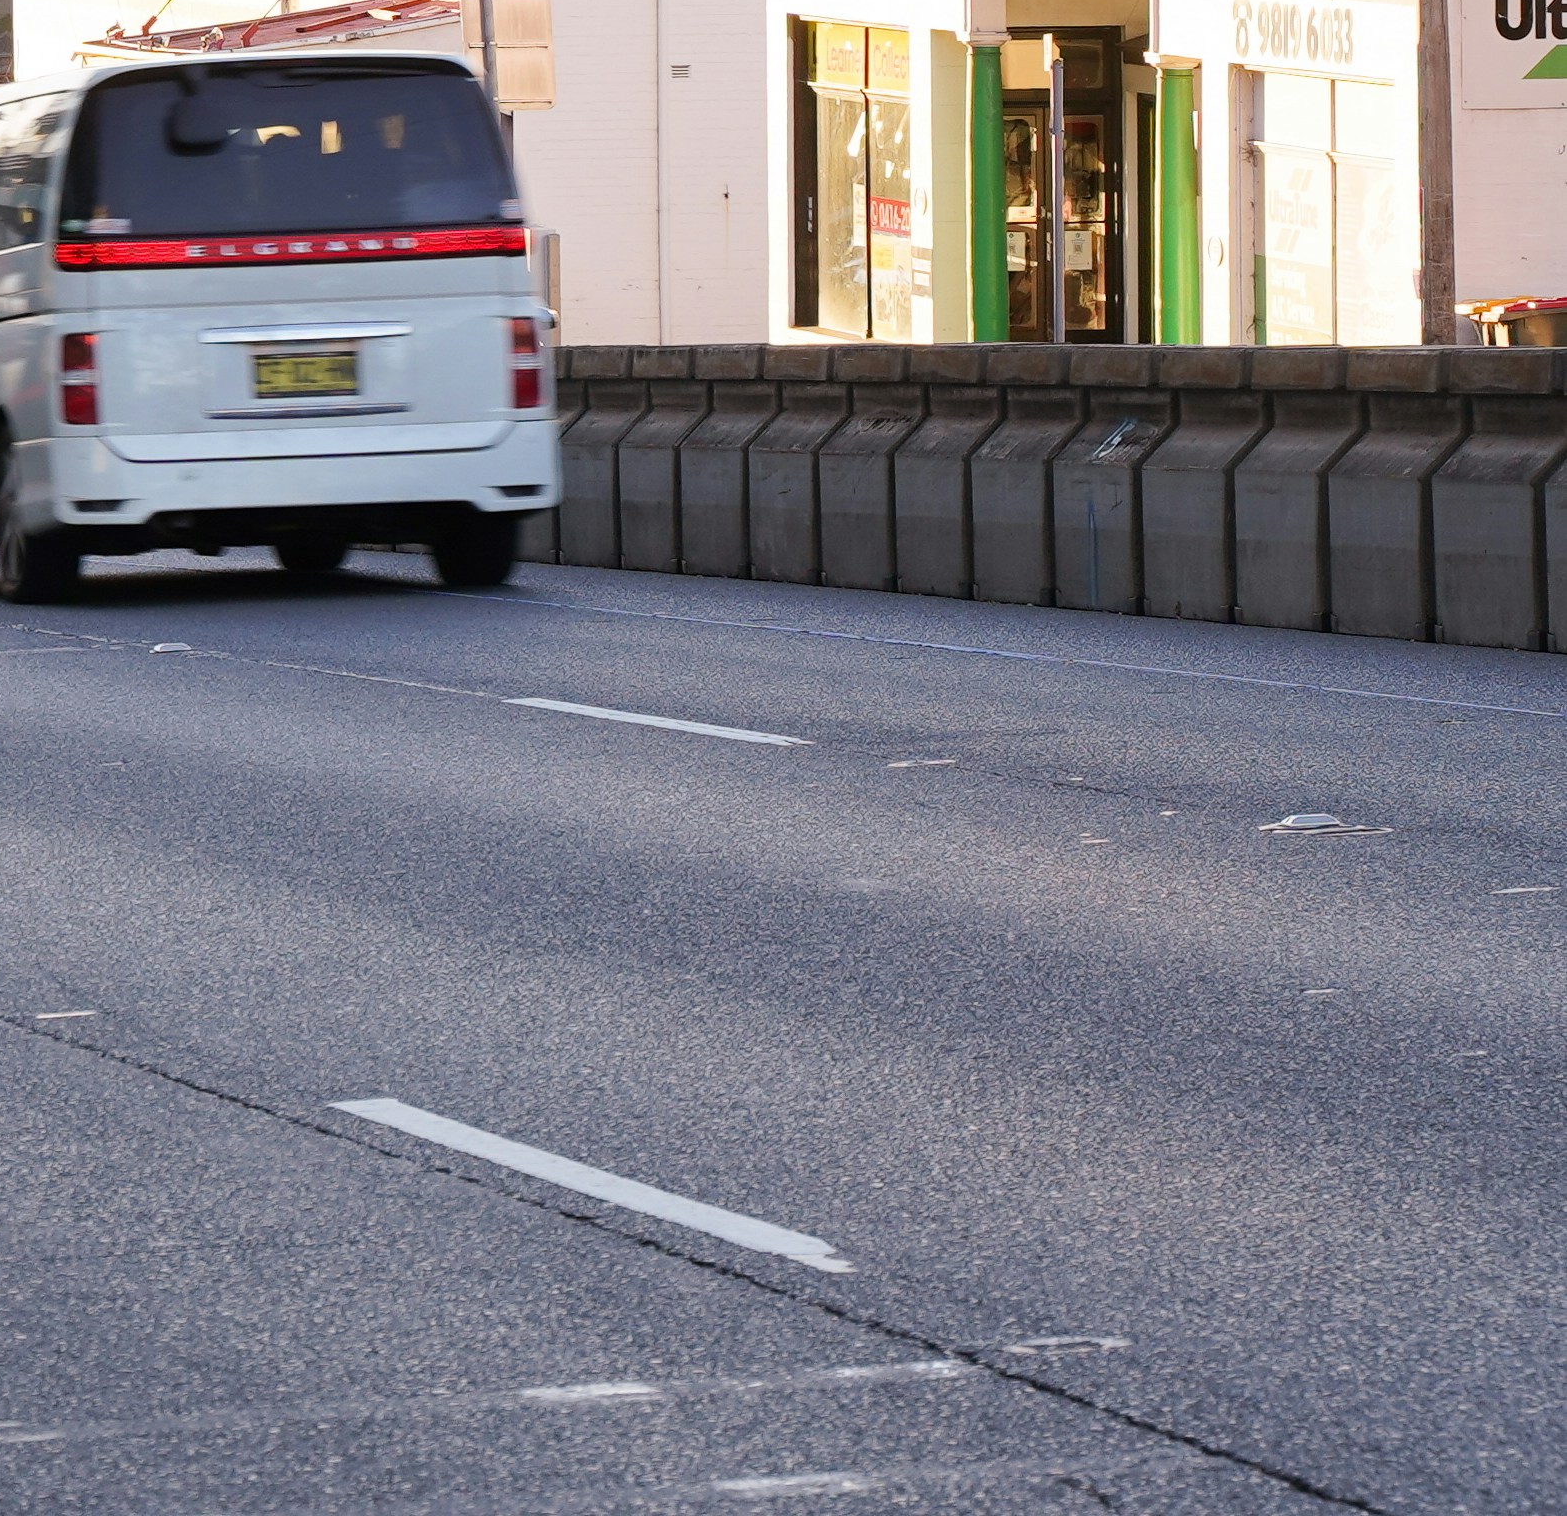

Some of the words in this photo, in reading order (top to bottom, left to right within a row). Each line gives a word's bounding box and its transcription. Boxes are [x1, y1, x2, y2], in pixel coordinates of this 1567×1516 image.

[1258, 0, 1302, 59] 9819
[1307, 5, 1354, 65] 6033
[185, 236, 418, 258] ELGRAND
